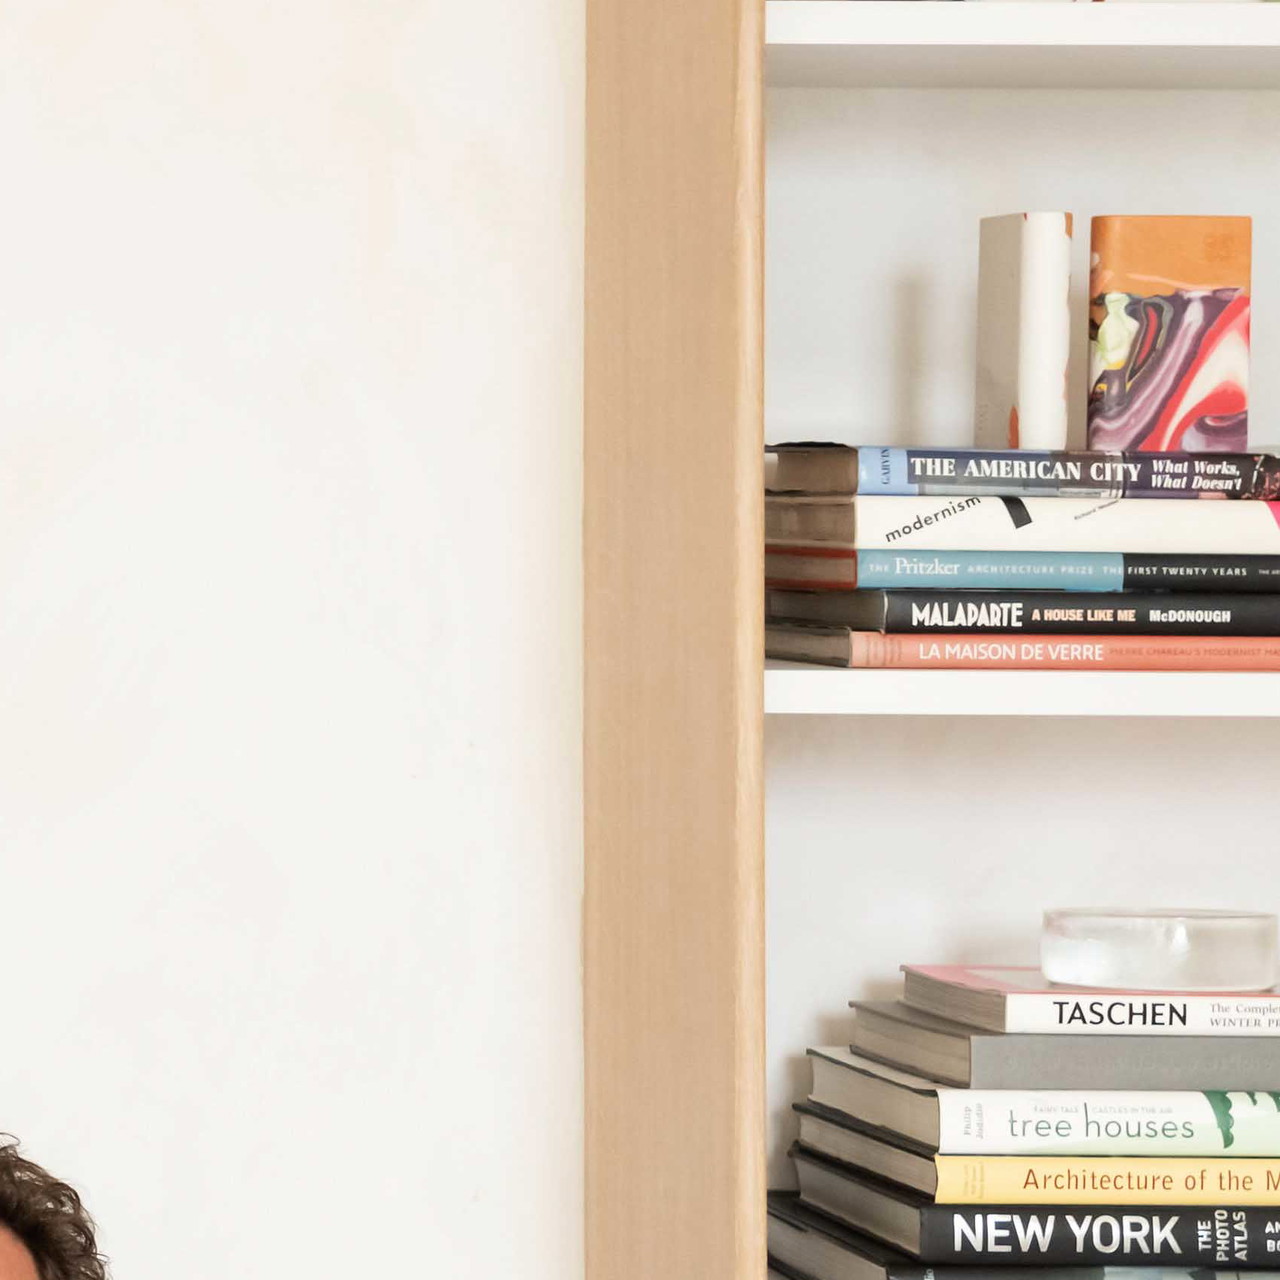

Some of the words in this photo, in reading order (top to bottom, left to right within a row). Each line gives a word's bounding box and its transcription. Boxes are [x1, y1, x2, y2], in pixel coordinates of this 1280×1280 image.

[911, 457, 956, 477] THE
[963, 458, 1081, 481] AMERICAN
[1089, 461, 1142, 482] CITY
[1151, 458, 1189, 474] What
[1193, 462, 1240, 477] Works,
[1150, 473, 1187, 489] What
[1191, 475, 1242, 491] Doesn't
[884, 496, 981, 543] modernism
[894, 557, 961, 575] Pritzker
[967, 565, 1054, 573] ARCHITECTURE
[1060, 565, 1094, 574] PRIZE
[1127, 567, 1158, 575] FIRST
[1162, 567, 1207, 575] TWENTY
[1212, 567, 1248, 576] YEARS
[911, 601, 1023, 628] MALAPARTE
[1031, 609, 1041, 621] A
[1043, 609, 1085, 622] HOUSE
[1087, 609, 1114, 622] LIKE
[1117, 609, 1137, 622] ME
[1148, 609, 1231, 623] McDONOUGH
[919, 643, 941, 659] LA
[944, 644, 1017, 660] MAISON
[1020, 644, 1044, 660] DE
[1046, 644, 1104, 661] VERRE
[1052, 1001, 1187, 1026] TASCHEN
[1210, 1003, 1231, 1013] The
[1210, 1018, 1261, 1028] WINTER
[1008, 1109, 1072, 1138] tree
[1083, 1102, 1195, 1139] houses
[1023, 1168, 1174, 1191] Architecture
[1184, 1169, 1207, 1191] of
[1219, 1170, 1253, 1191] the
[952, 1212, 1055, 1254] NEW
[1064, 1214, 1183, 1255] YORK
[1197, 1220, 1212, 1252] THE
[1214, 1209, 1229, 1262] PHOTO
[1232, 1210, 1248, 1261] ATLAS
